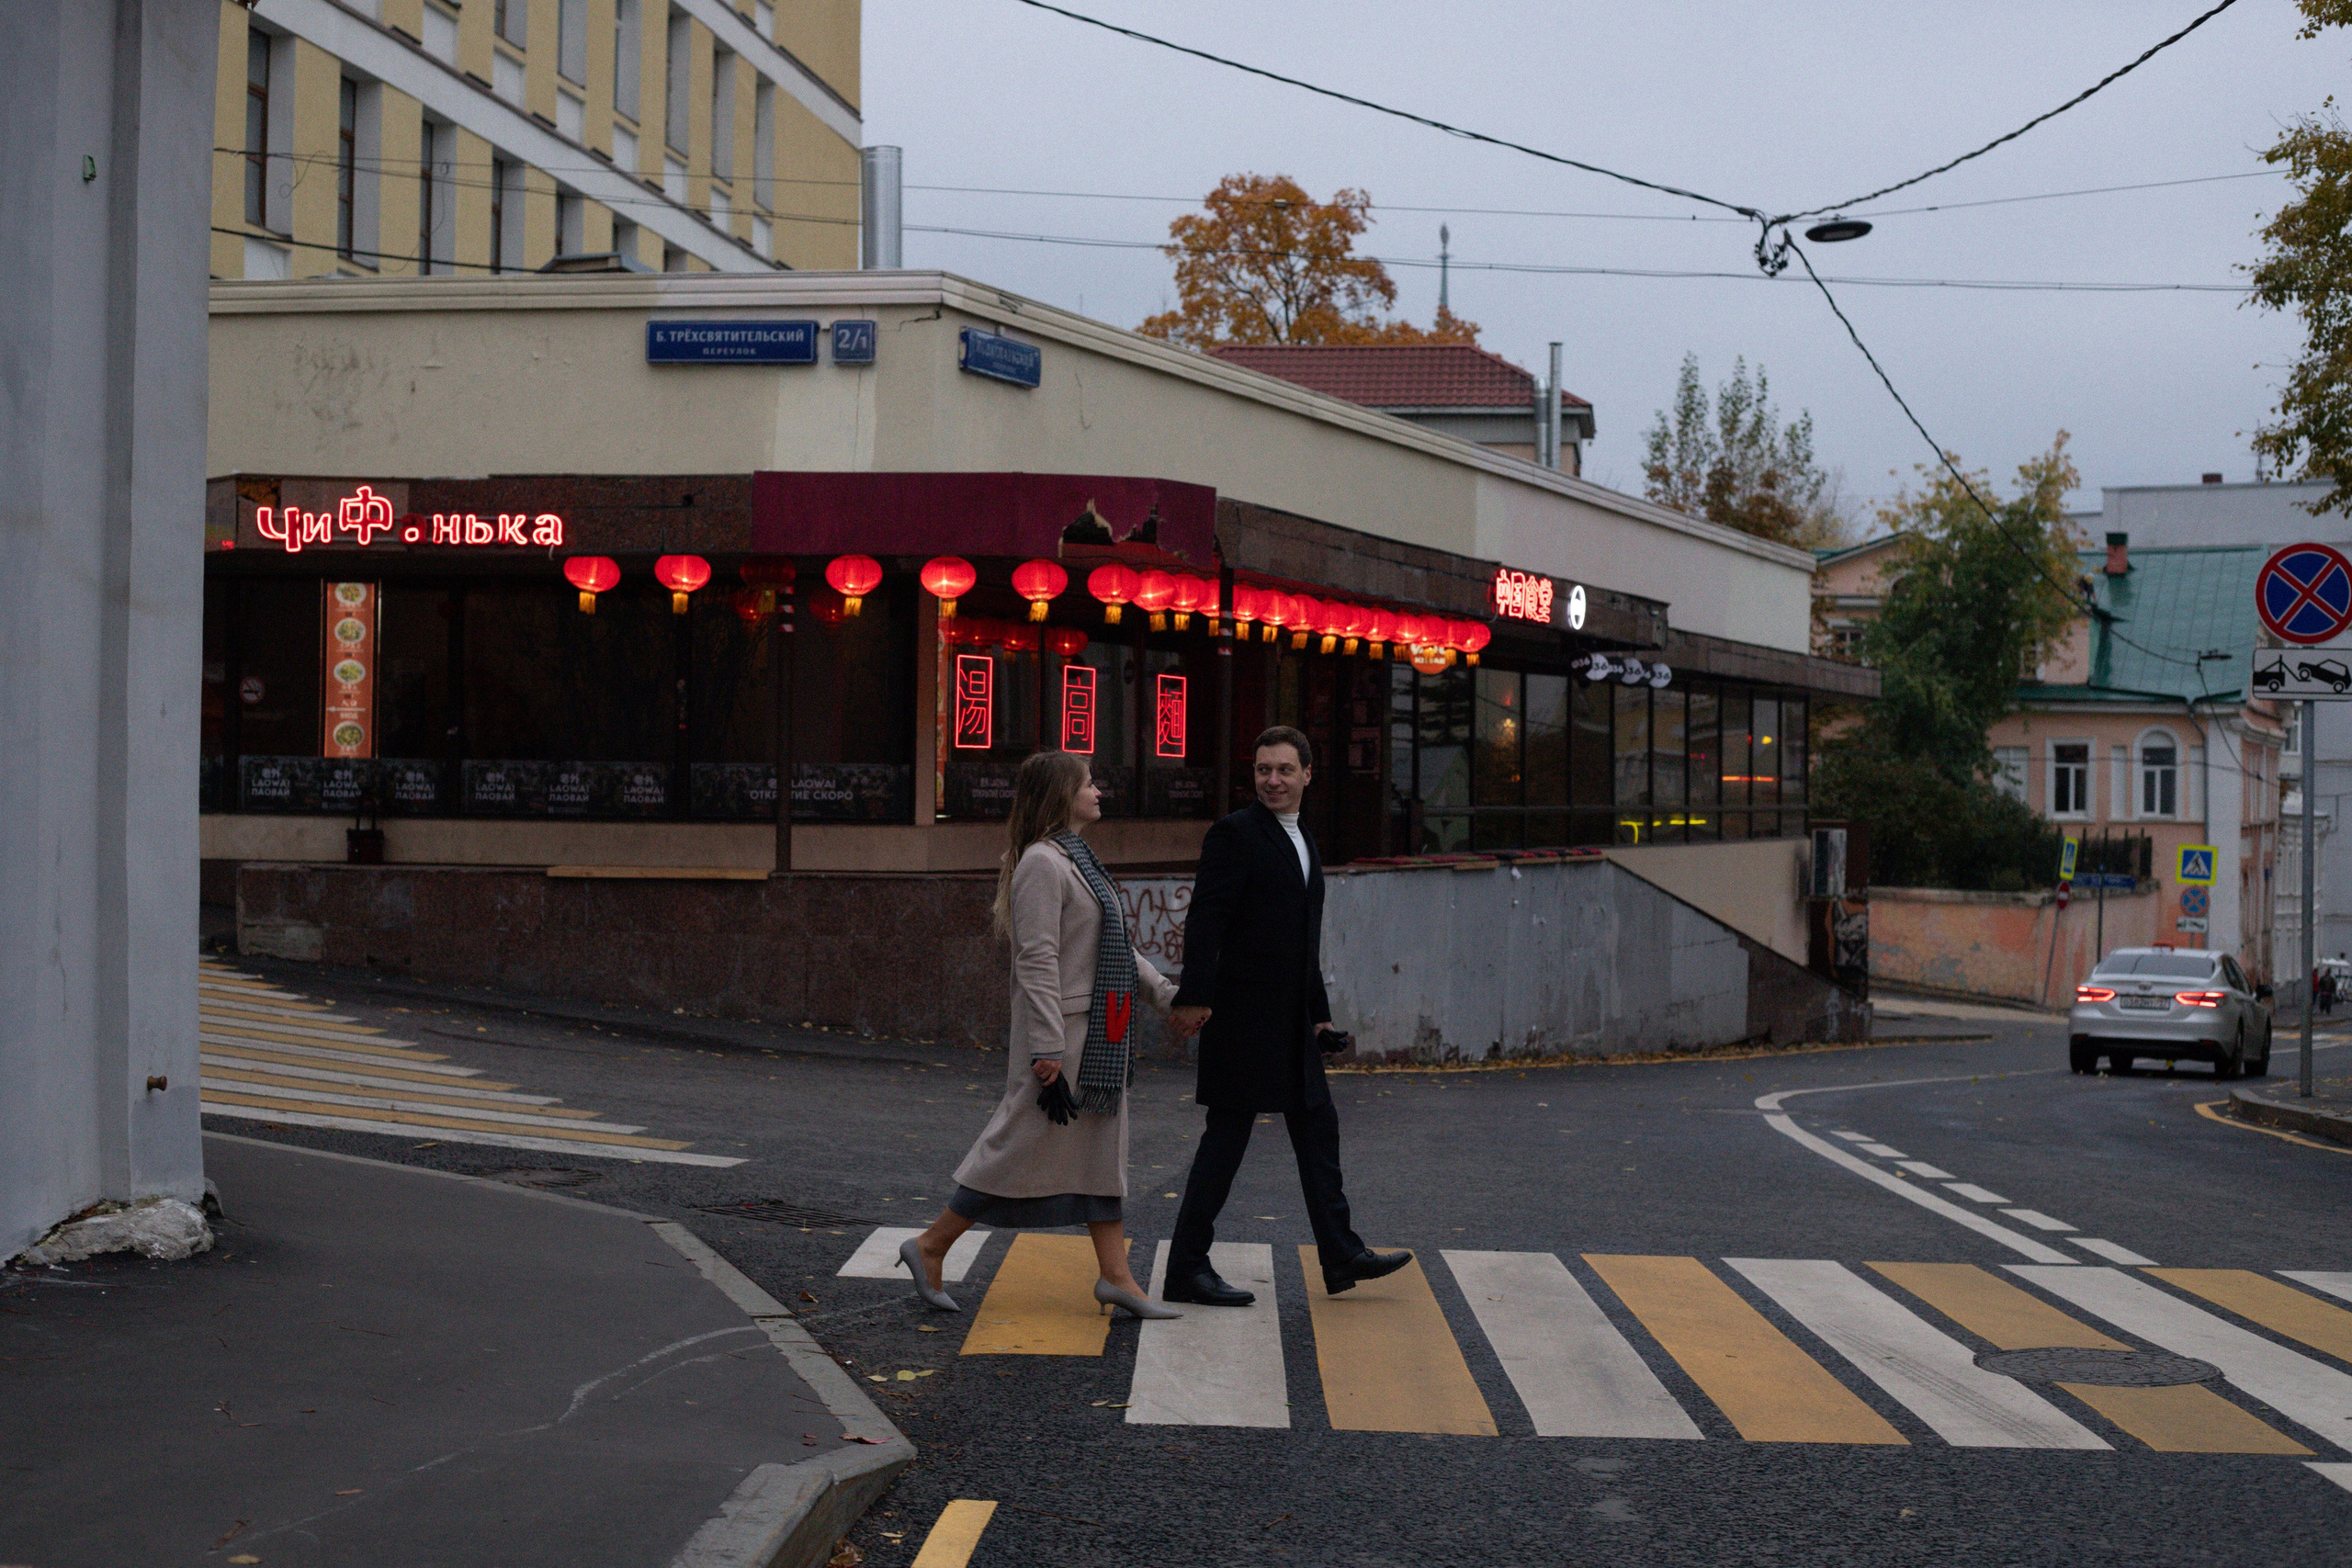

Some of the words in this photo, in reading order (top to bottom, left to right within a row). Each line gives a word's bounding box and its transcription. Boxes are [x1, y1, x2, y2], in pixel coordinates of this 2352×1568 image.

[655, 330, 667, 343] Б.
[669, 328, 805, 343] ТРЁХСВЯТИТЕЛЬСКИЙ
[837, 327, 867, 351] 2/1
[702, 346, 757, 355] ПЕРЕУЛОК
[957, 668, 988, 735] 湯
[1066, 676, 1092, 742] 高
[790, 778, 837, 789] LAOWAI
[813, 790, 854, 801] СКОРО
